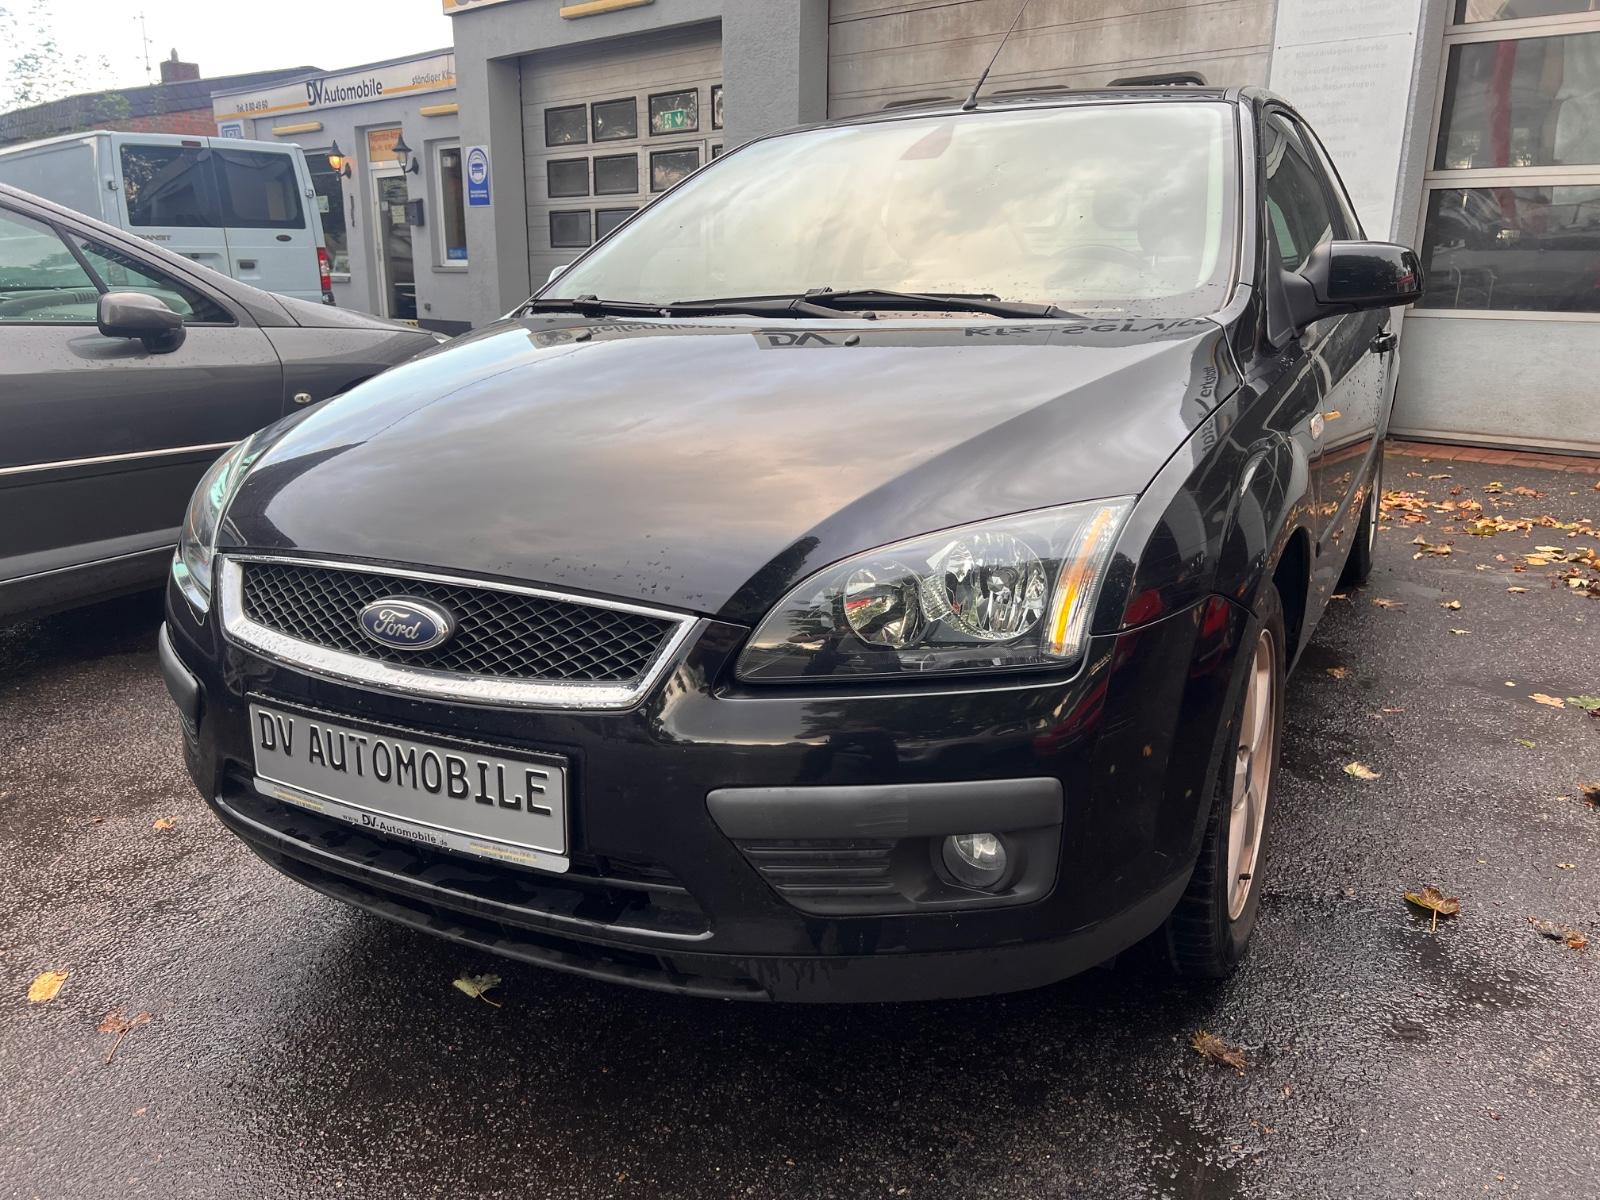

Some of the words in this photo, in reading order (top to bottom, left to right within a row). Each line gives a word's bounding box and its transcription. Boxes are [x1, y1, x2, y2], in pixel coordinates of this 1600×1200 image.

[306, 79, 324, 106] DV
[324, 78, 383, 104] Automobile
[373, 608, 422, 640] Ford
[257, 708, 295, 757] DV
[309, 723, 553, 817] AUTOMOBILE
